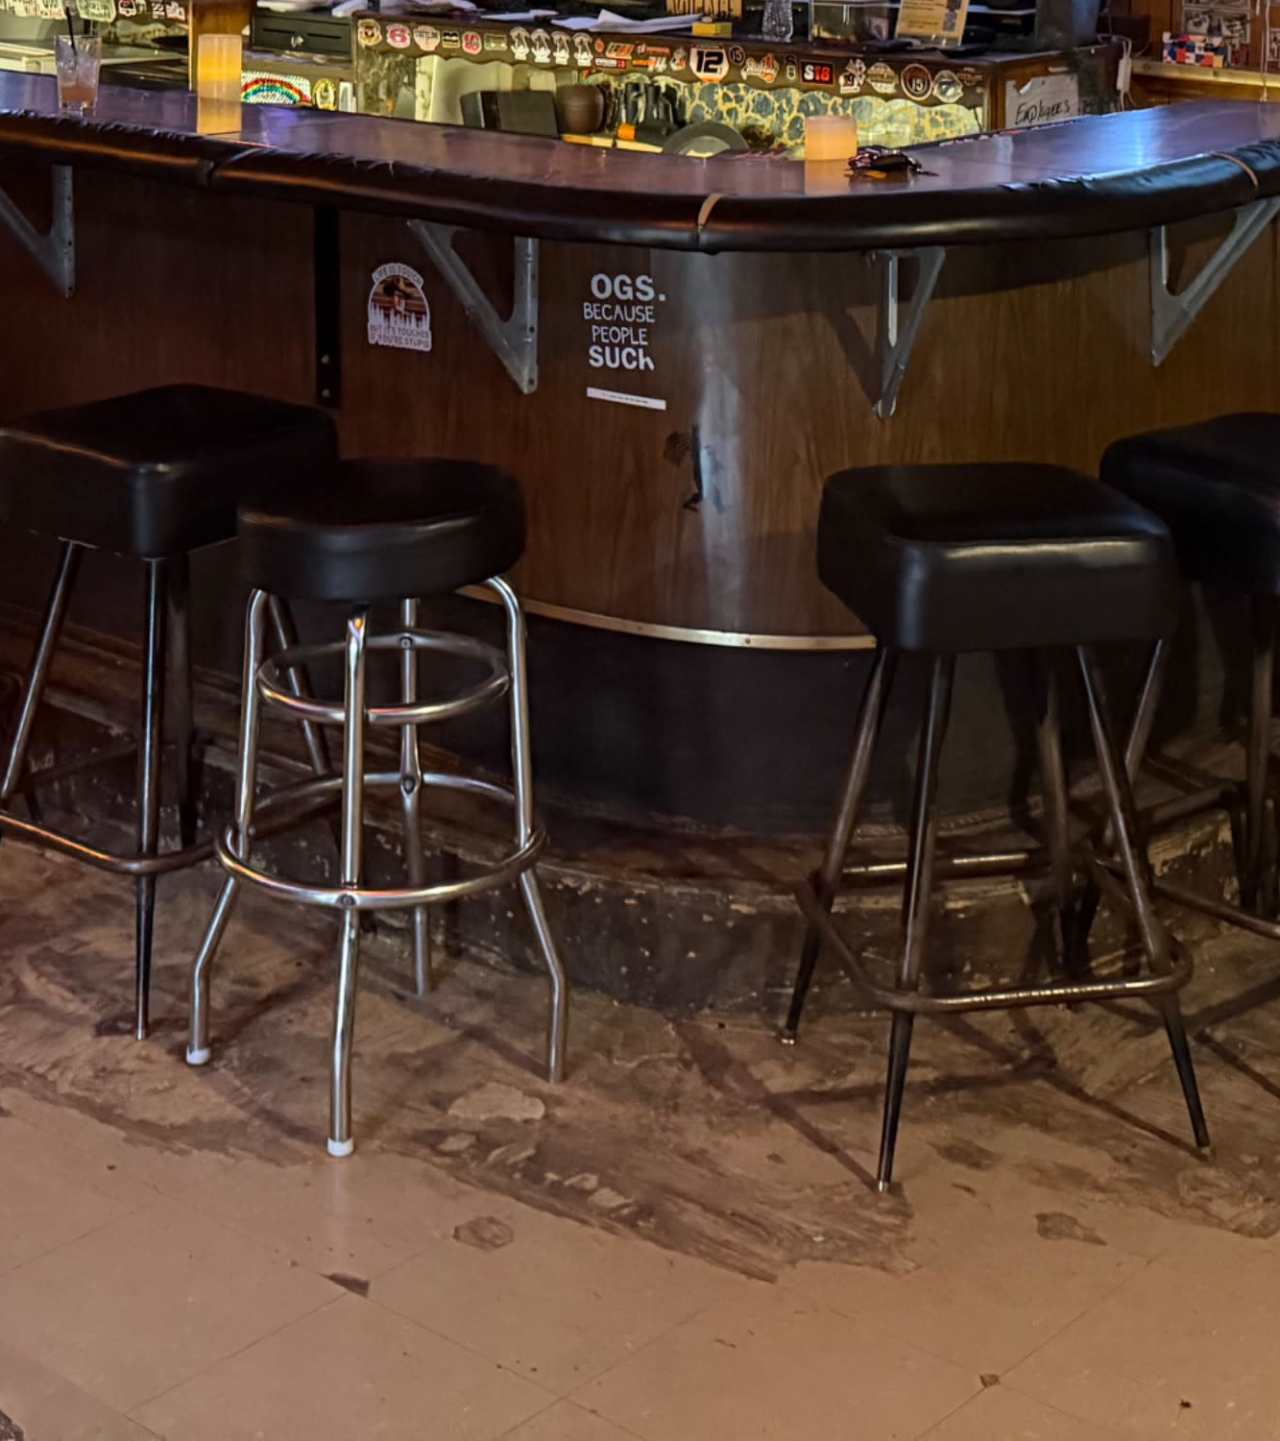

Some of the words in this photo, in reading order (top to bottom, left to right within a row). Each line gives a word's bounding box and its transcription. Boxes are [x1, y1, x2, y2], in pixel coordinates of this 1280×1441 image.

[591, 273, 667, 302] OGS.
[583, 302, 656, 324] BECAUSE
[591, 324, 649, 347] PEOPLE
